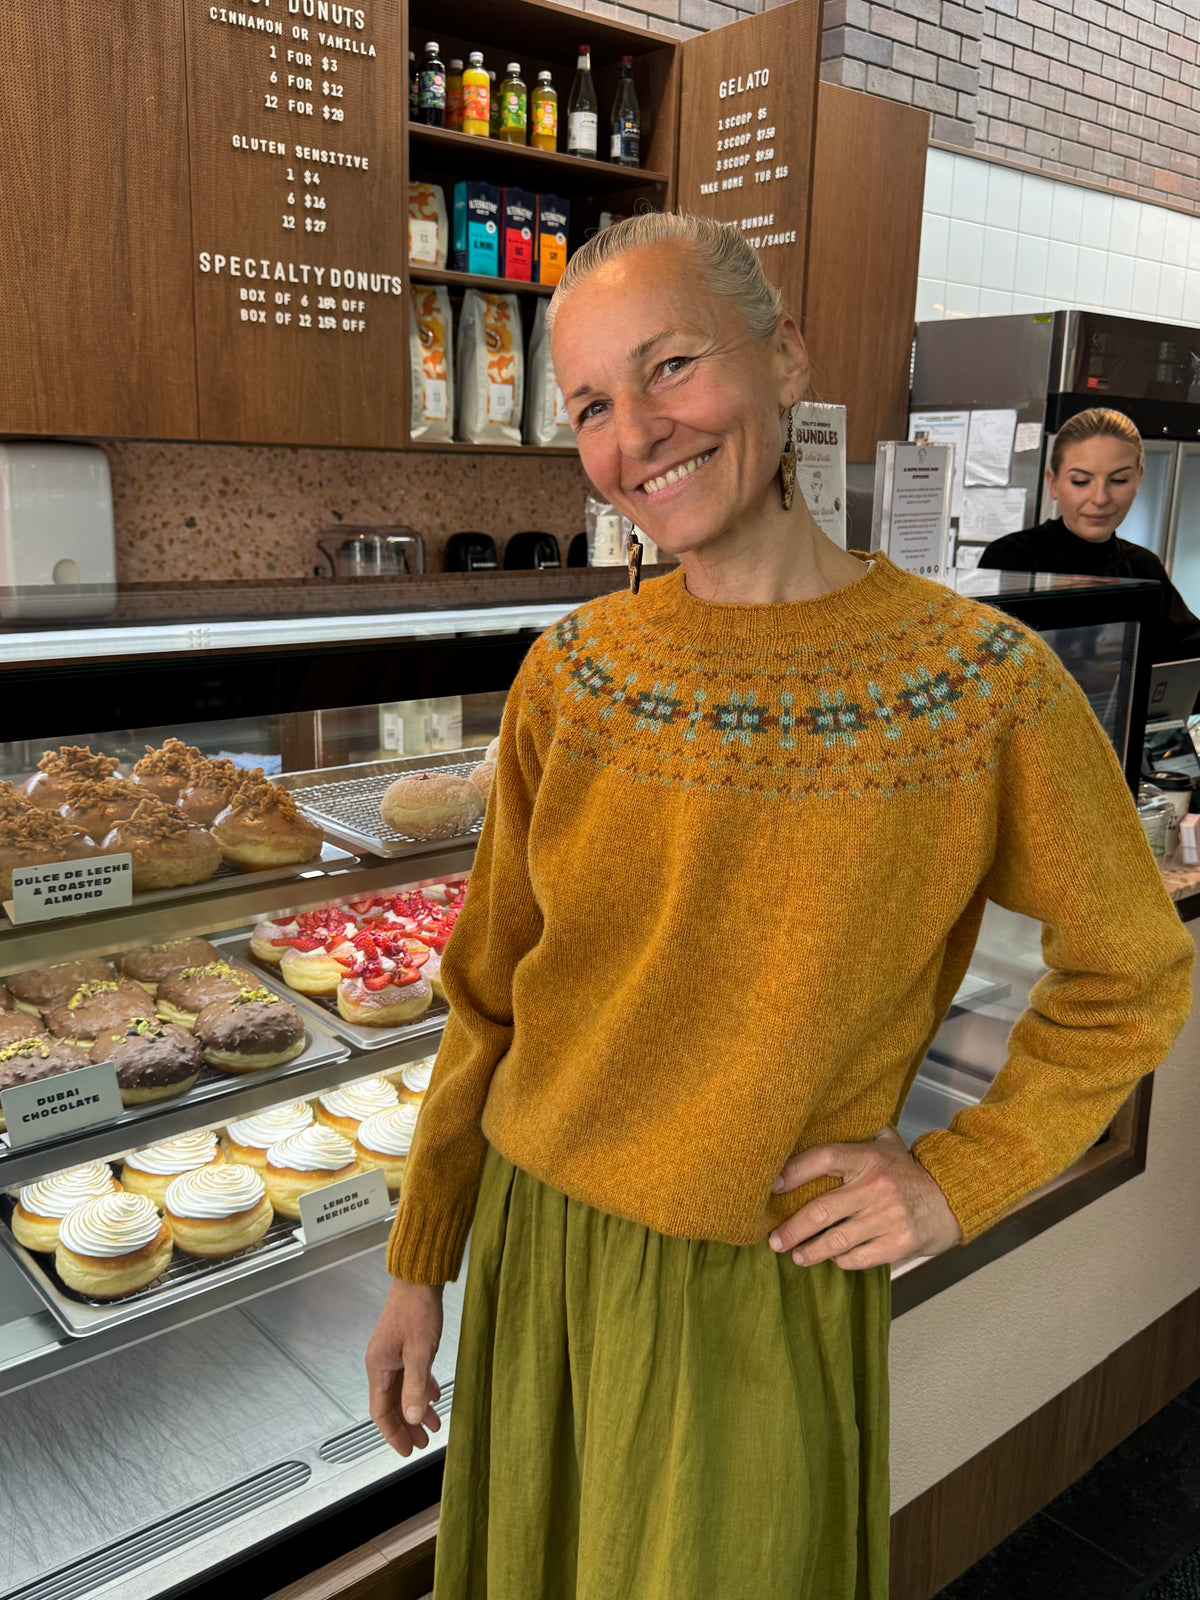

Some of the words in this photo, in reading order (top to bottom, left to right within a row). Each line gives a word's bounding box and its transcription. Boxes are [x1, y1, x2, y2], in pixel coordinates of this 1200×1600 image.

[288, 0, 365, 30] DONUTS
[210, 6, 283, 35] CINNAMON
[292, 26, 309, 41] OR
[318, 32, 376, 57] VANILLA
[269, 45, 277, 59] 1
[287, 50, 312, 67] FOR
[321, 56, 338, 72] $3
[270, 71, 278, 84] 6
[287, 74, 313, 91] FOR
[322, 80, 344, 98] $12
[719, 68, 770, 99] GELATO
[264, 94, 278, 109] 12
[288, 99, 313, 116] FOR
[322, 105, 344, 122] $28
[718, 119, 724, 131] 1
[724, 112, 752, 129] SCOOP
[757, 107, 767, 121] $5
[232, 134, 286, 156] GLUTEN
[295, 145, 369, 170] SENSITIVE
[717, 140, 723, 152] 2
[723, 133, 751, 150] SCOOP
[715, 160, 722, 172] 3
[722, 154, 751, 171] SCOOP
[286, 168, 294, 181] 1
[304, 170, 320, 185] $4
[700, 180, 719, 195] TAKE
[721, 176, 744, 191] HOME
[754, 171, 772, 184] TUB
[775, 166, 789, 180] $15
[287, 192, 295, 205] 6
[304, 193, 326, 210] $16
[282, 215, 296, 229] 12
[304, 217, 327, 233] $27
[741, 213, 775, 231] SUNDAE
[199, 252, 326, 286] SPECIALTY
[330, 268, 402, 296] DONUTS
[240, 288, 266, 303] BOX
[274, 291, 292, 306] OF
[300, 294, 309, 308] 6
[341, 298, 366, 313] OFF
[240, 308, 267, 324] BOX
[275, 311, 292, 326] OF
[298, 314, 312, 328] 12
[342, 319, 366, 333] OFF
[796, 429, 838, 445] BUNDLES
[14, 873, 60, 887] DULCE
[64, 870, 83, 880] DE
[87, 863, 130, 876] LECHE
[33, 887, 42, 895] &
[48, 877, 112, 893] ROASTED
[44, 889, 103, 905] ALMOND
[22, 1094, 100, 1123] CHOCOLATE
[37, 1088, 79, 1106] DUBAI
[316, 1198, 370, 1224] MERINGUE
[323, 1192, 359, 1211] LEMON
